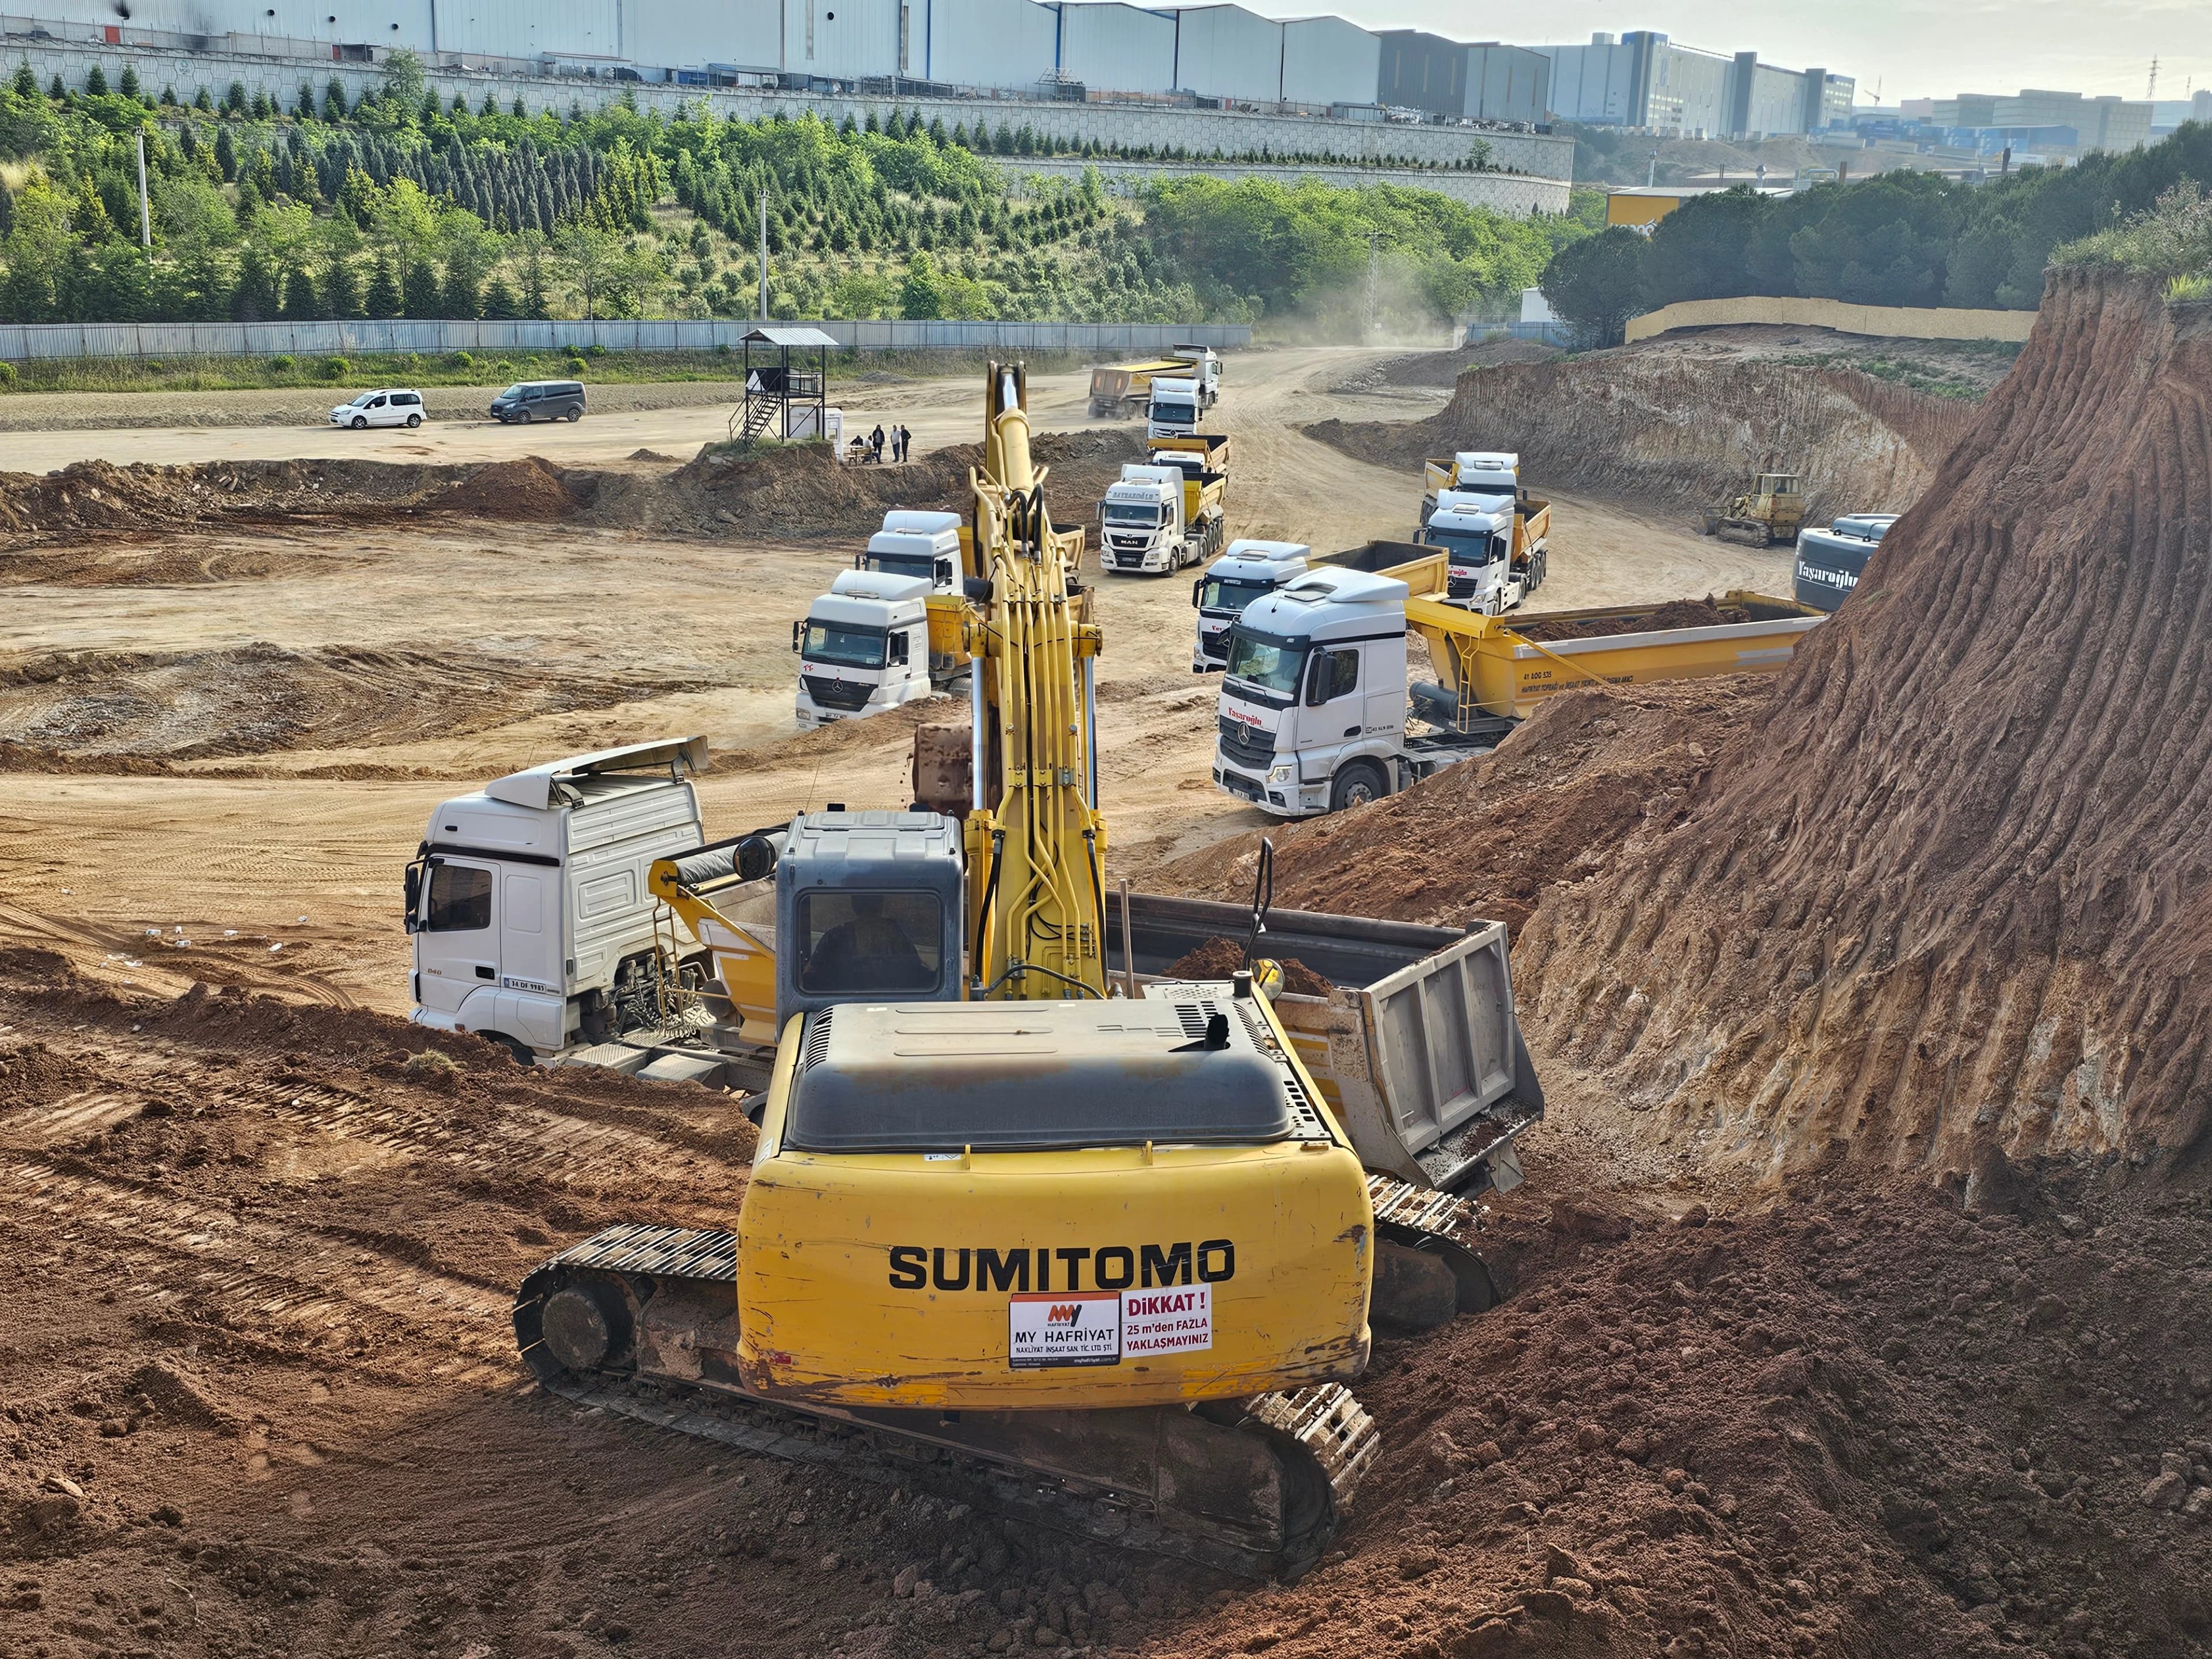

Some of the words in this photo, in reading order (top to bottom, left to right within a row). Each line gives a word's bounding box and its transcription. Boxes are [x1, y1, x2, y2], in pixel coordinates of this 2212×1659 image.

[889, 1239, 1234, 1291] SUMITOMO
[1015, 1331, 1037, 1343] MY
[1045, 1327, 1114, 1343] HAFRİYAT
[1127, 1325, 1139, 1335] 25
[1176, 1317, 1207, 1331] FAZLA
[1127, 1333, 1209, 1351] YAKLAŞMAYINIZ
